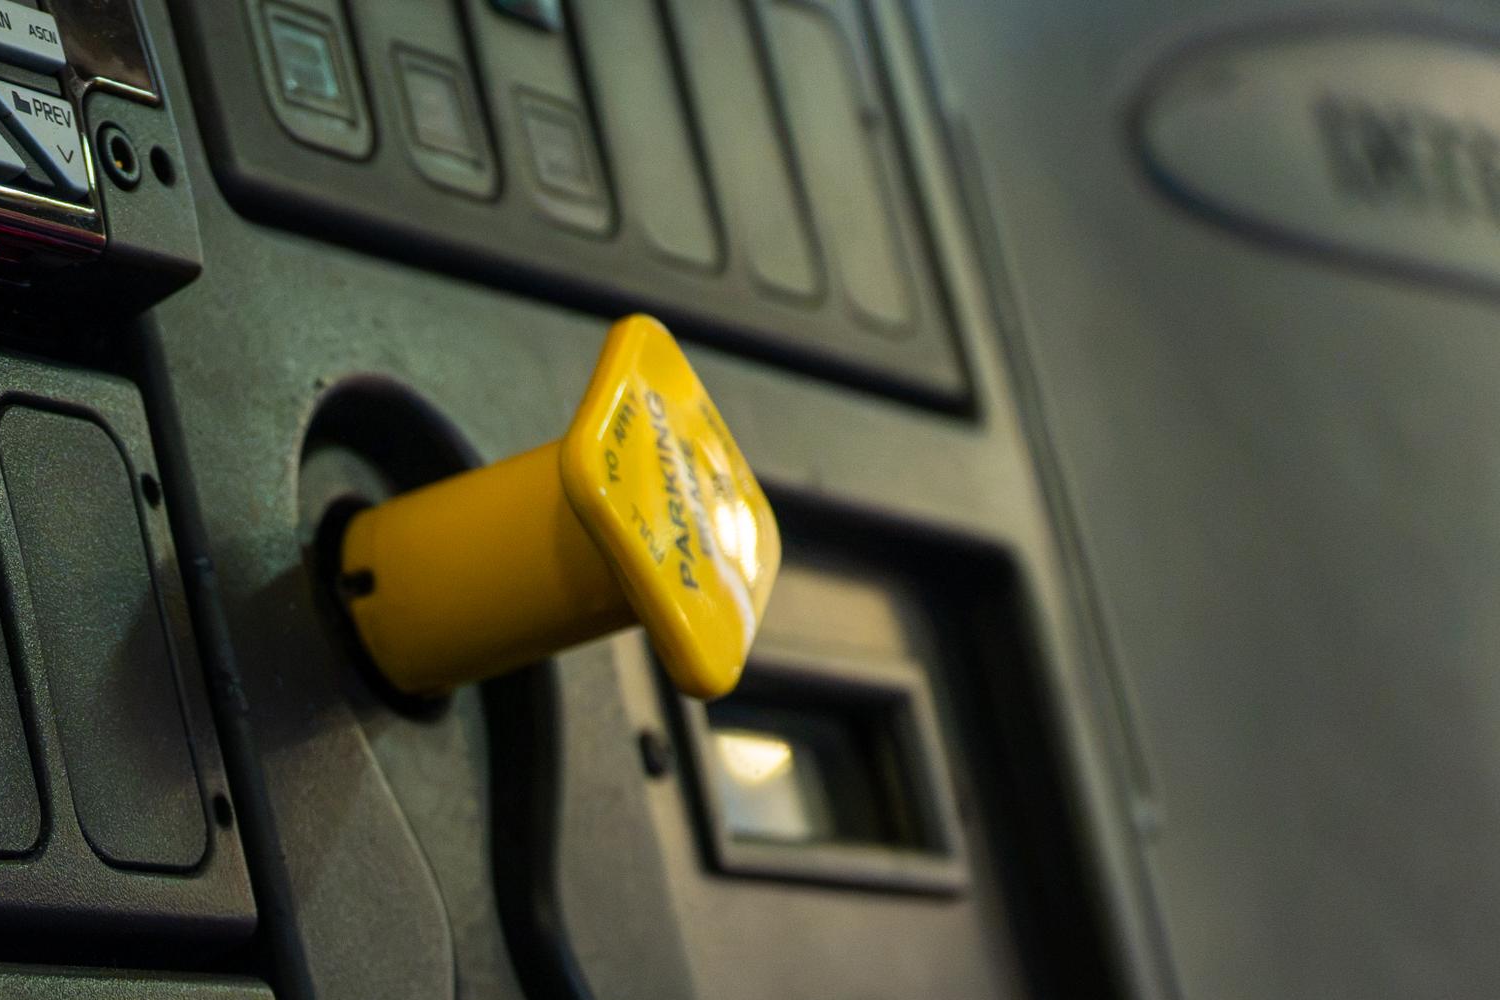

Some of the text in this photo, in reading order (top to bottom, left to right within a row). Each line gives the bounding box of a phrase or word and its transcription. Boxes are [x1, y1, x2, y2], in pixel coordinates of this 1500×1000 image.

[28, 24, 59, 45] ASCN
[32, 98, 72, 129] PREV
[604, 448, 621, 484] TO
[645, 389, 699, 590] PARKING
